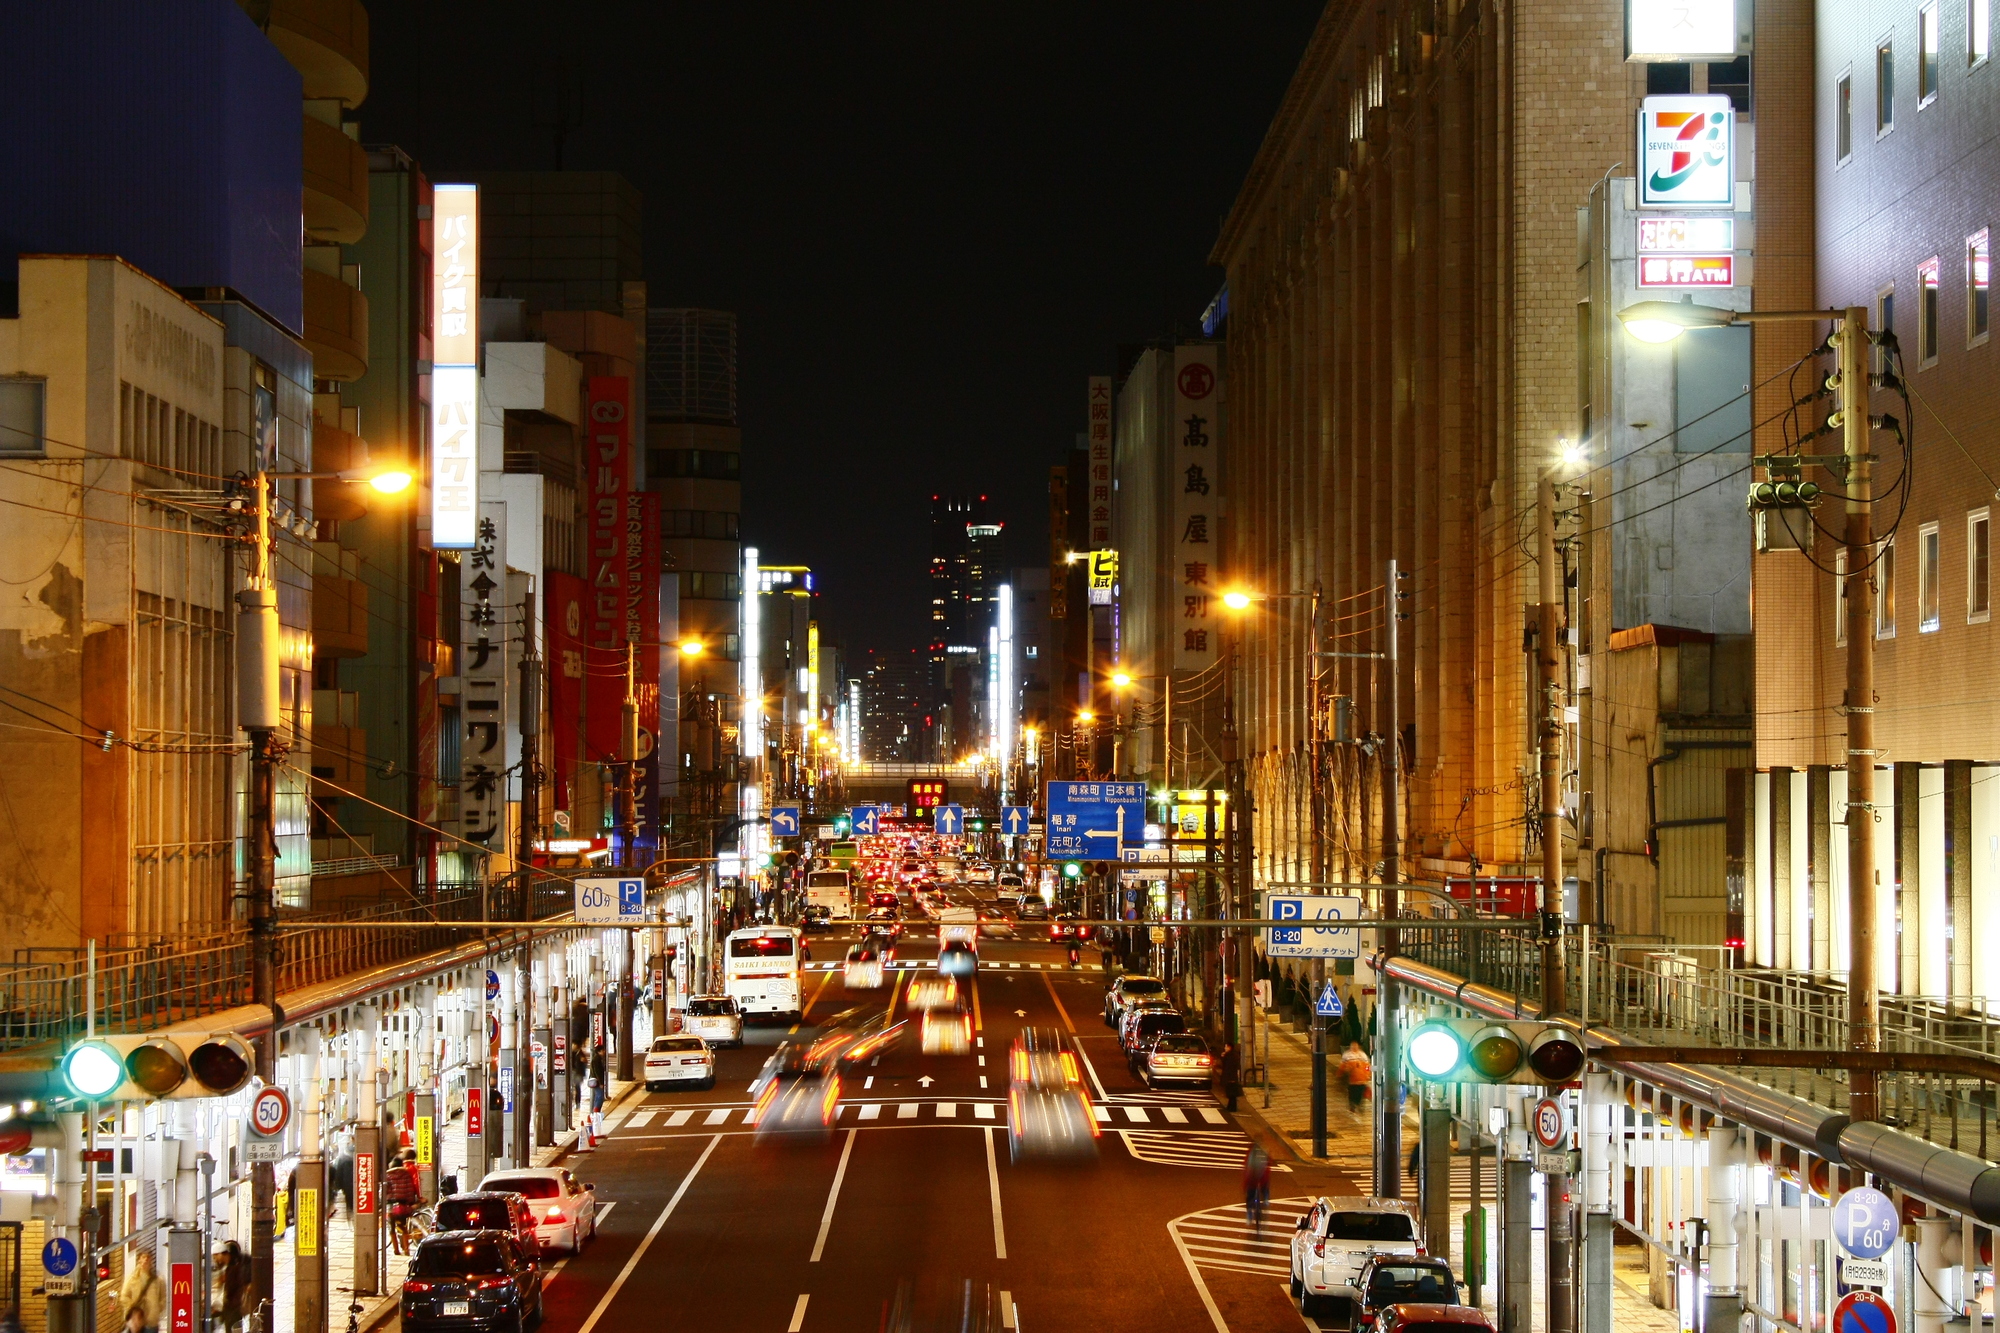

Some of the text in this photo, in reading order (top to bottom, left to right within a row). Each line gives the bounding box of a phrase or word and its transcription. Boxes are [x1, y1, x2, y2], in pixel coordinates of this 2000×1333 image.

[441, 214, 468, 338] バイク買取
[438, 401, 472, 512] バイク王
[1091, 383, 1109, 543] 大阪厚生信用金庫
[1183, 562, 1208, 652] 東別館
[1068, 785, 1100, 796] 南森町
[917, 796, 940, 805] 15分
[1051, 815, 1077, 826] 稲荷
[1051, 836, 1082, 847] 元町2
[582, 886, 611, 908] 60分
[625, 883, 638, 902] P
[620, 904, 642, 913] 8-20
[1281, 903, 1297, 920] P
[1274, 930, 1300, 942] 8-20
[1271, 947, 1355, 956] パーキング・チケット
[260, 1102, 279, 1121] 50
[1541, 1112, 1557, 1133] 50
[358, 1156, 367, 1210] でんでんタウン
[1854, 1193, 1878, 1204] 8-20
[1847, 1203, 1873, 1247] P
[1854, 1293, 1875, 1302] 20-8
